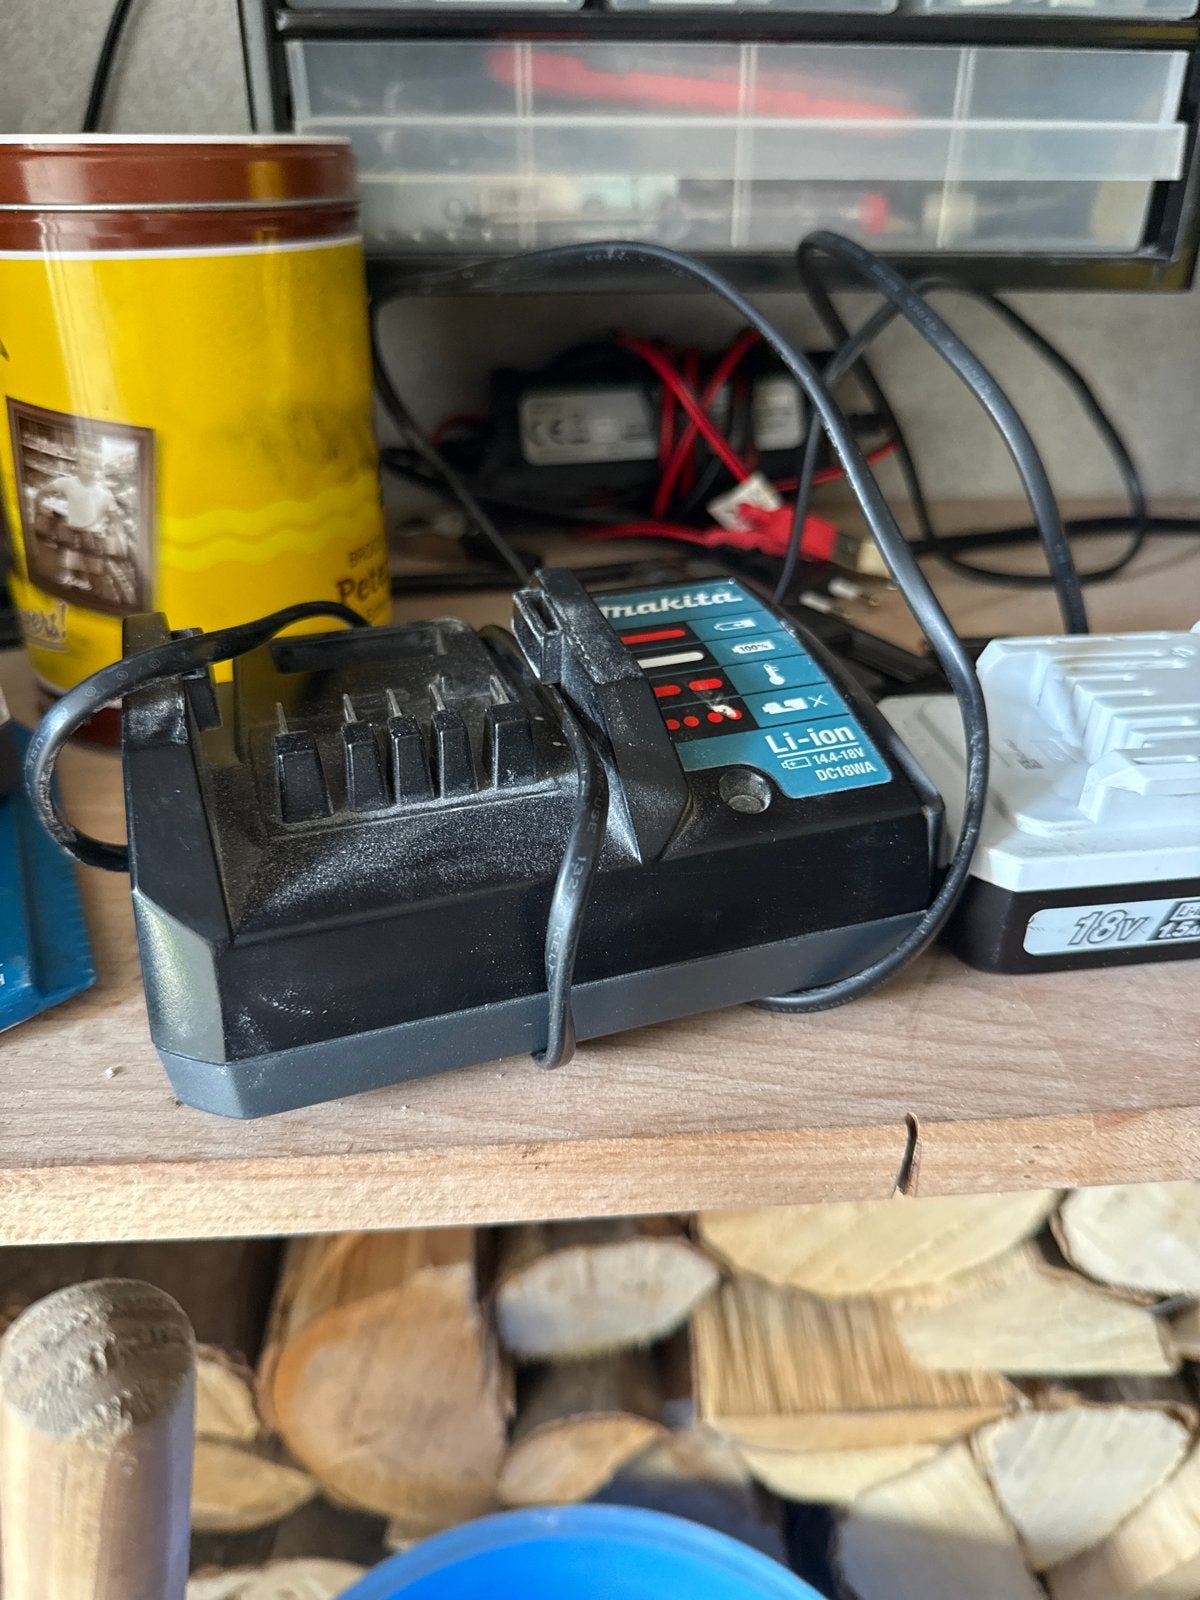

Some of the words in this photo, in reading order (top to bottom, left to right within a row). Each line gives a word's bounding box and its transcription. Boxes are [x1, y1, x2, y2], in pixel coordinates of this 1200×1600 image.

[600, 592, 743, 619] makita
[740, 643, 769, 652] 100%
[764, 726, 856, 754] Li-ion
[812, 747, 866, 765] 14.4-18V
[815, 761, 878, 782] DC18WA
